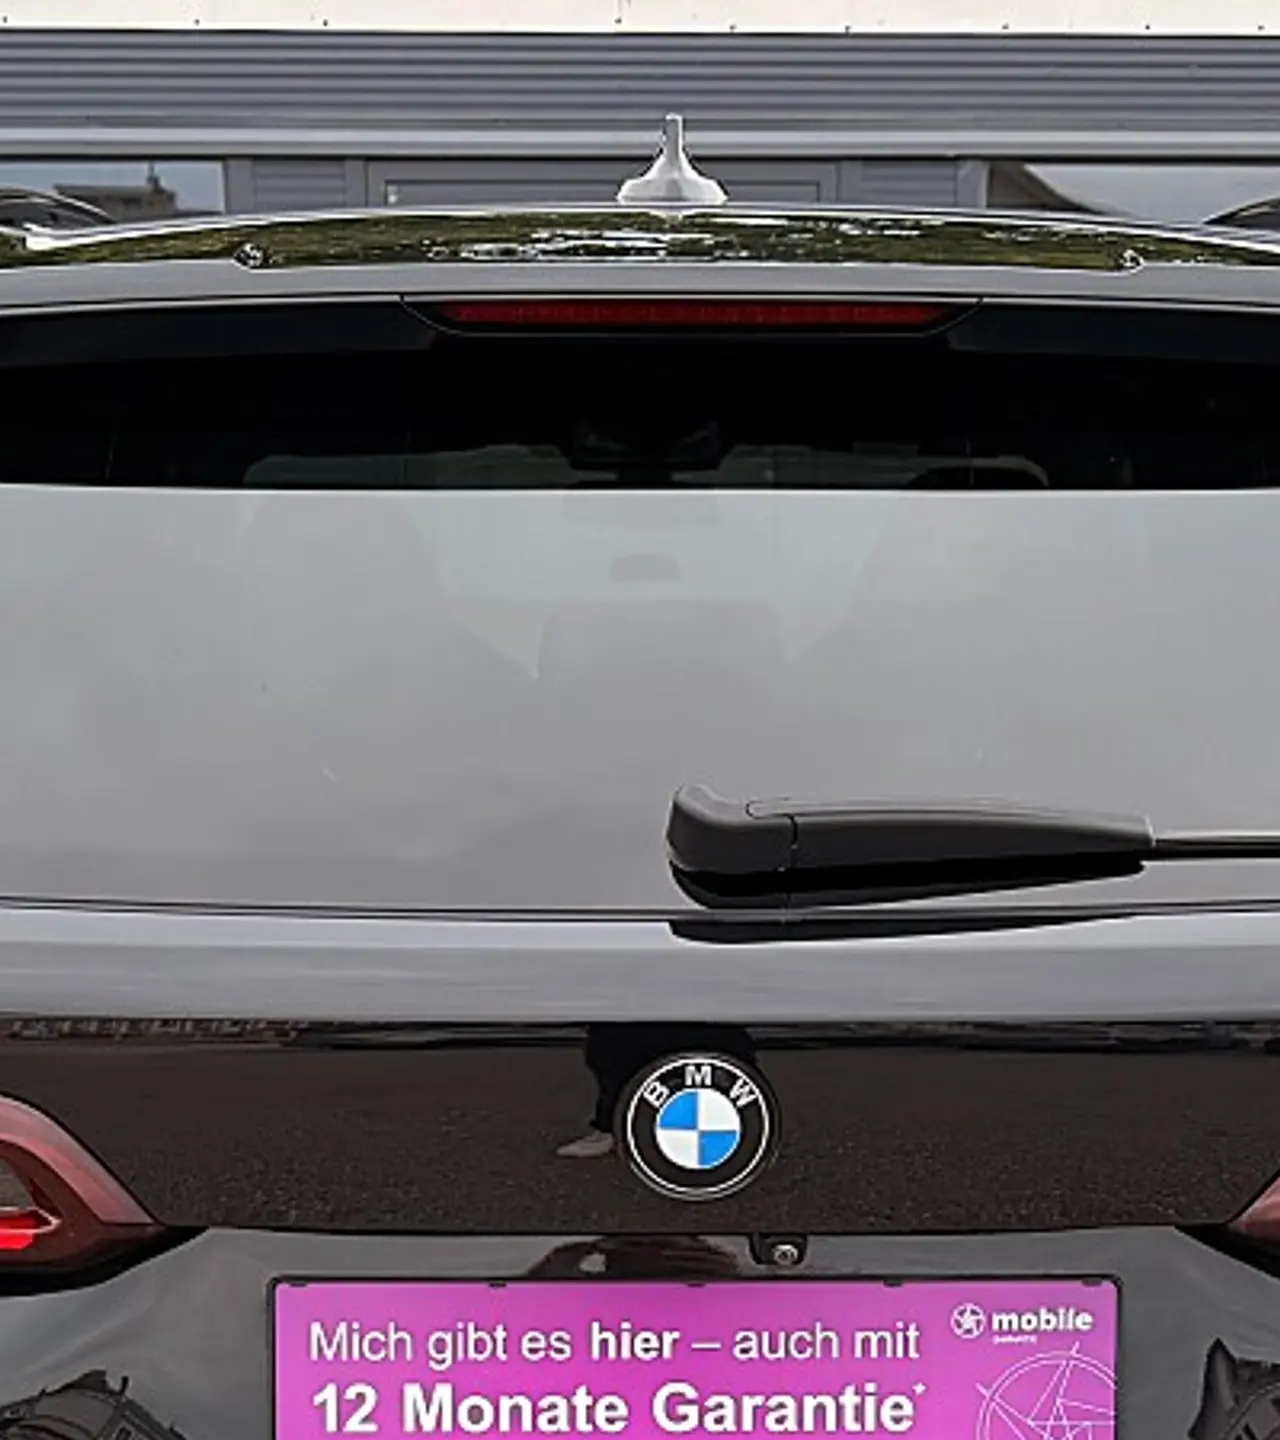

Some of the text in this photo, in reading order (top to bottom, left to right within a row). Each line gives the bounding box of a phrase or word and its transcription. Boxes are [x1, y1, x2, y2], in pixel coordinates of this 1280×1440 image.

[642, 1064, 758, 1110] BMW
[991, 1306, 1094, 1331] mobile
[310, 1320, 413, 1361] Mich
[427, 1320, 507, 1372] gibt
[521, 1330, 571, 1361] es
[591, 1320, 681, 1360] hier
[733, 1320, 839, 1360] auch
[854, 1320, 920, 1359] mit
[313, 1382, 378, 1433] 12
[403, 1382, 629, 1433] Monate
